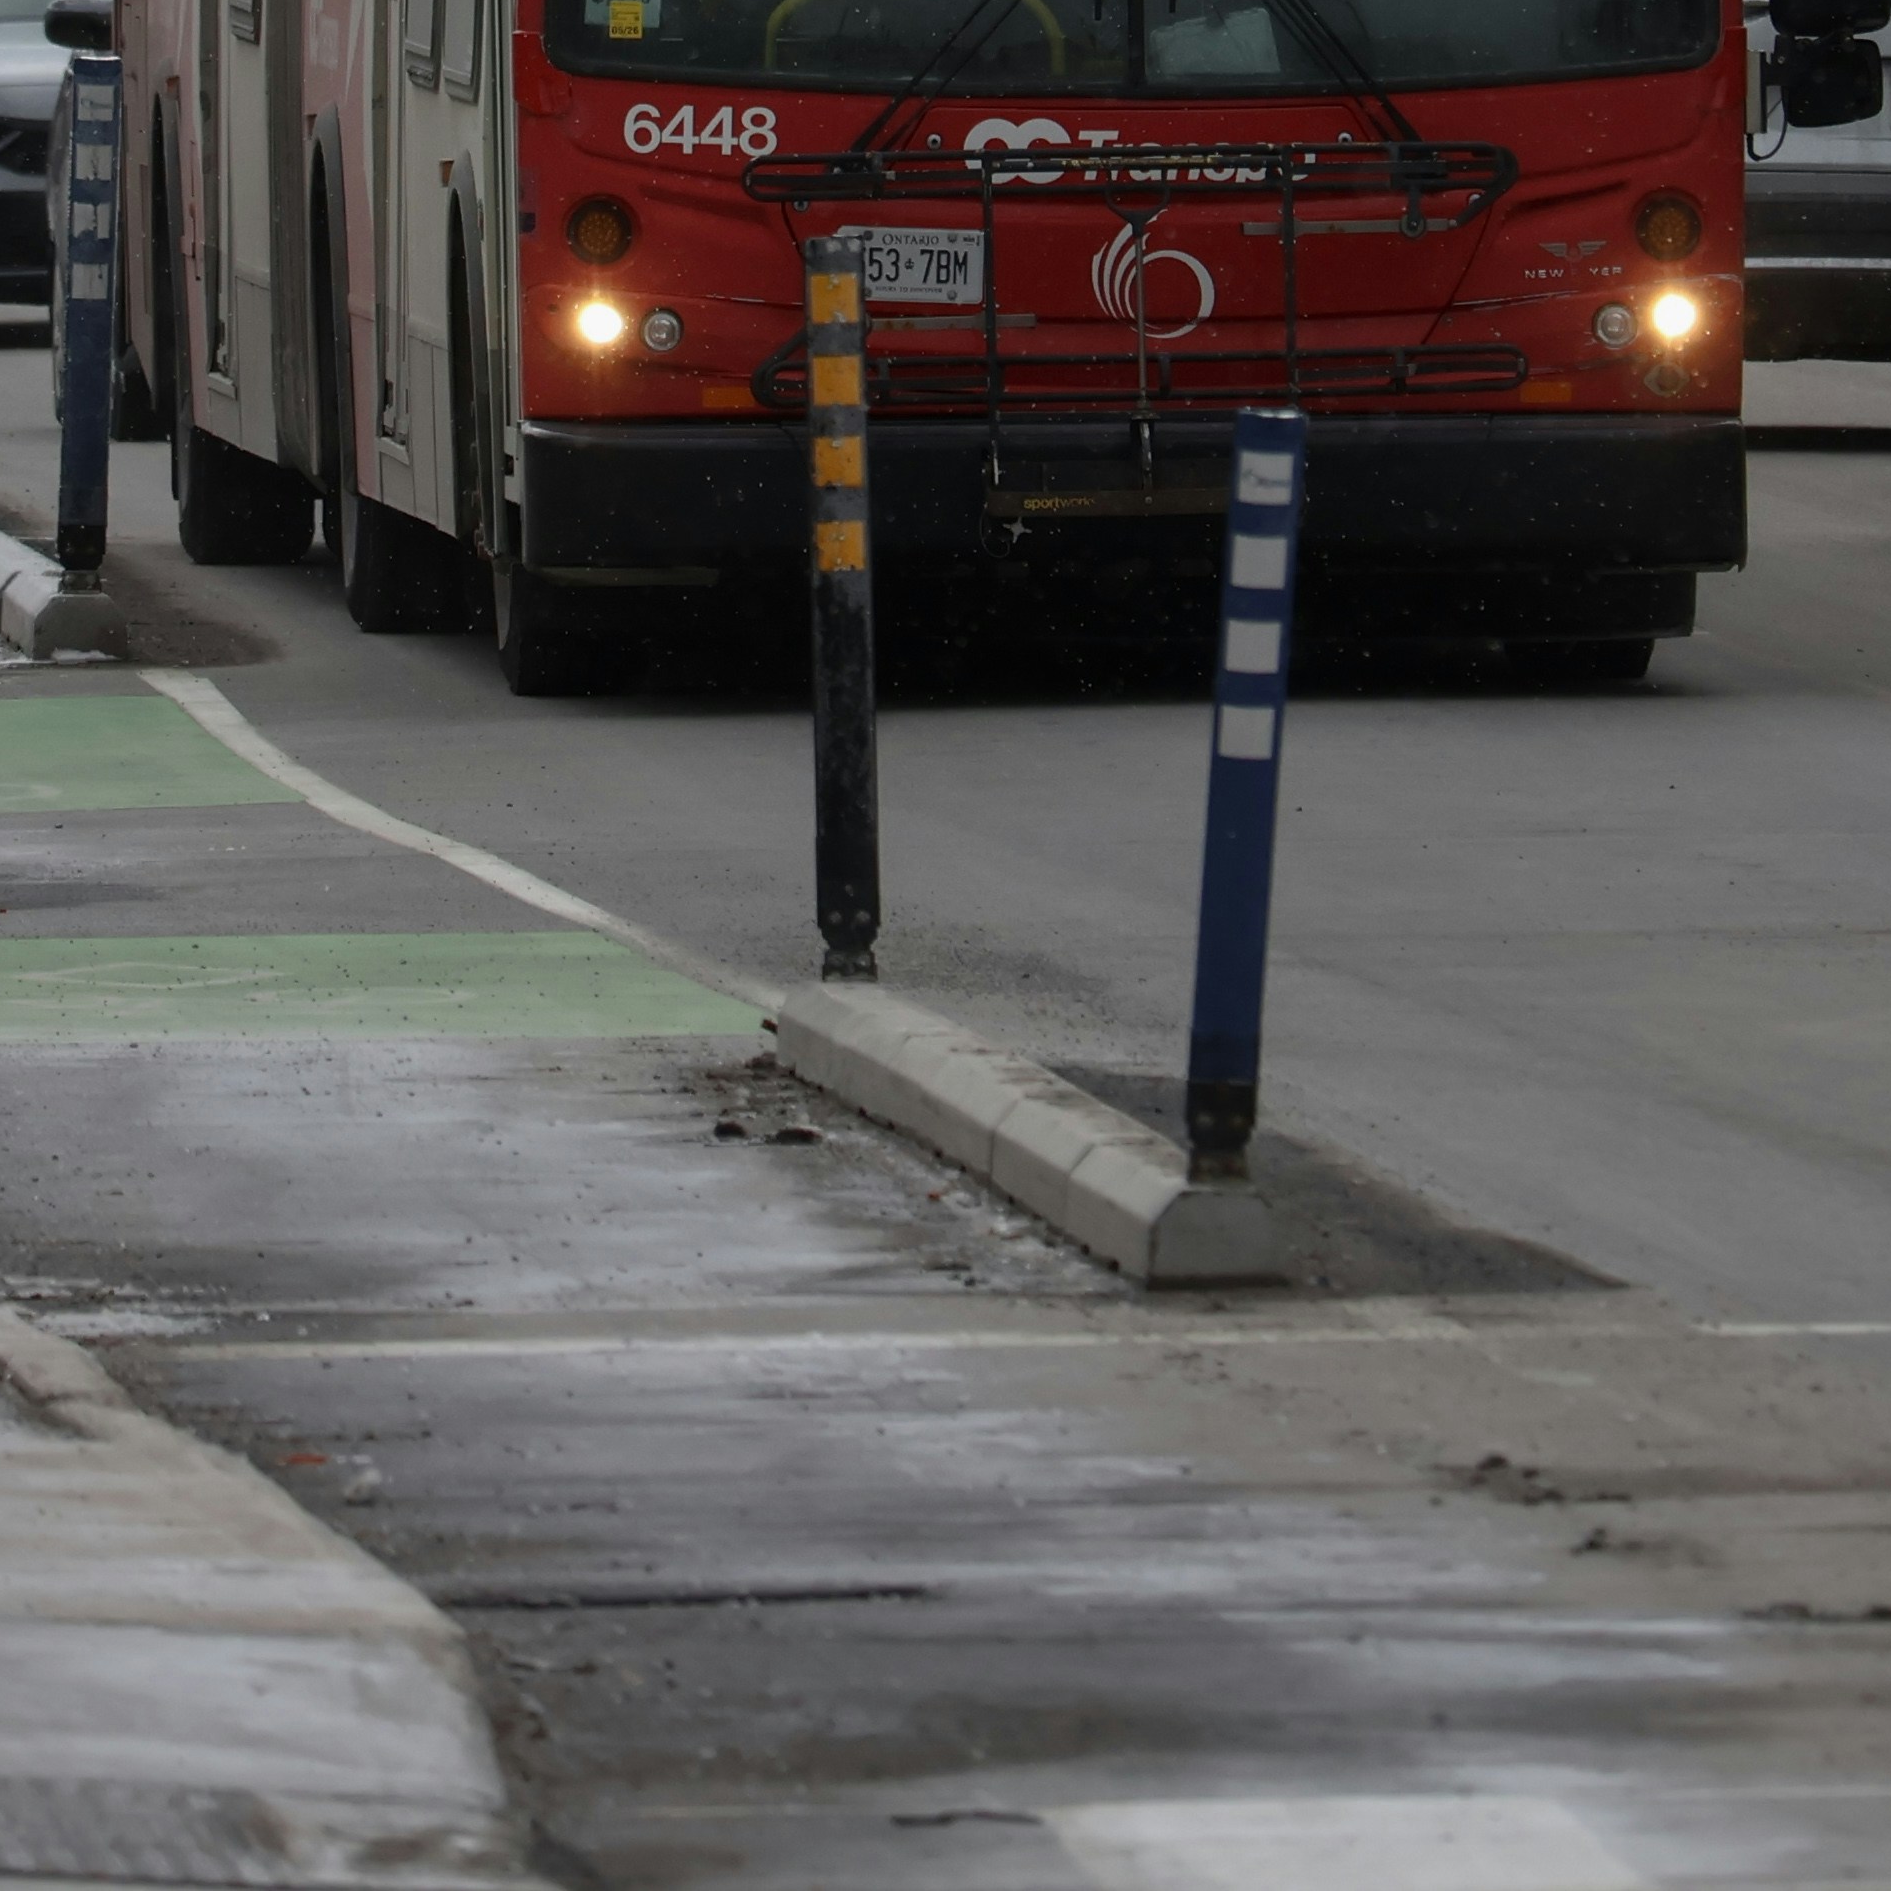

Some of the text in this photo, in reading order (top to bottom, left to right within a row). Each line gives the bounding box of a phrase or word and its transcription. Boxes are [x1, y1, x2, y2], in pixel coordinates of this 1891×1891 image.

[623, 103, 778, 157] 6448
[863, 247, 969, 285] 53 7BM
[1524, 269, 1564, 279] NEW
[1023, 496, 1096, 511] sportwork
